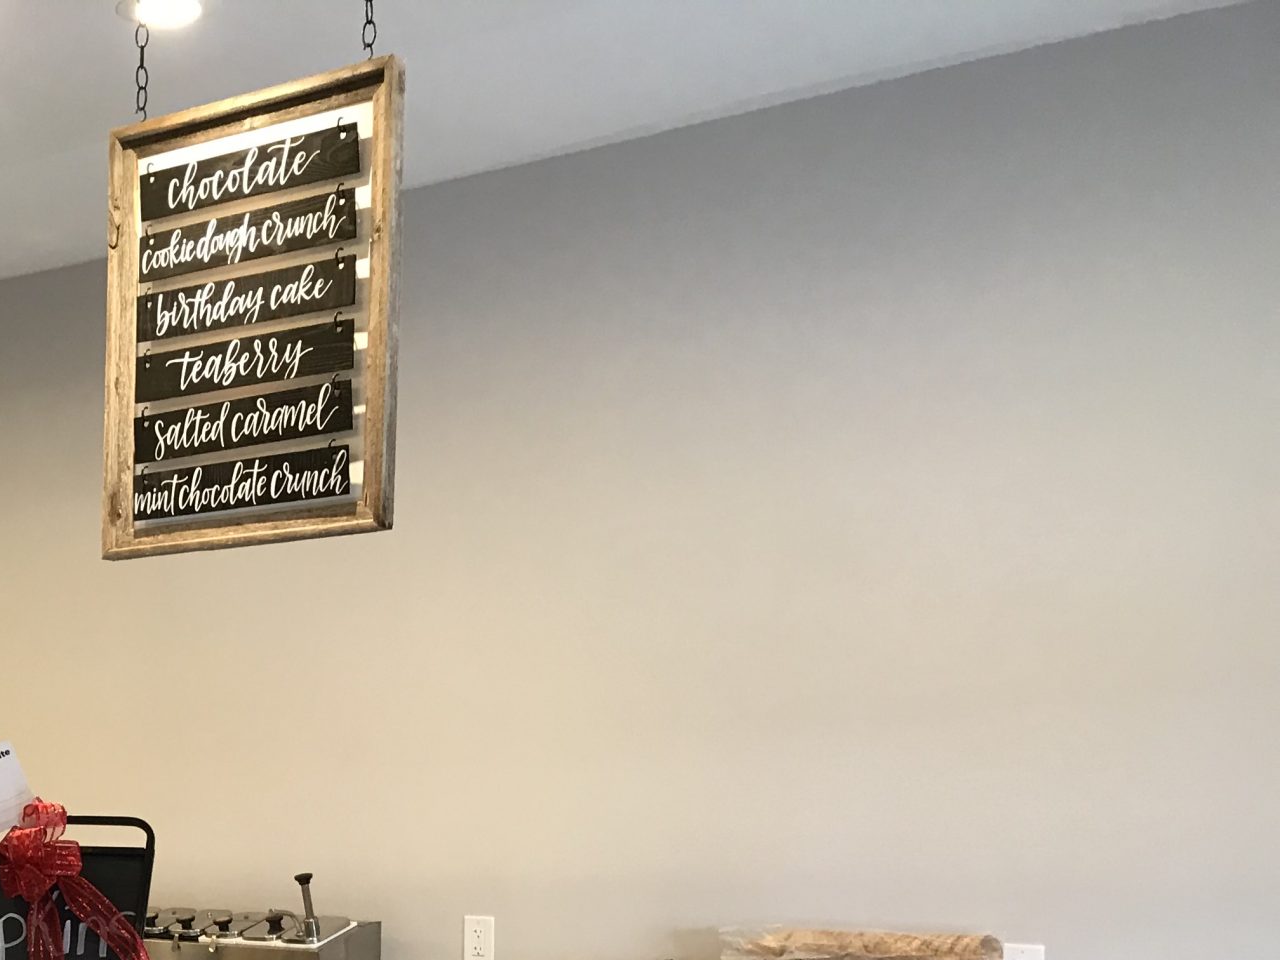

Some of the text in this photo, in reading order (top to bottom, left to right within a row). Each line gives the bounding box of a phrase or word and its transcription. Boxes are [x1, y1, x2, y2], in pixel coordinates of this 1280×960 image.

[168, 136, 320, 209] chocolate
[141, 193, 346, 274] cookie dough crunch
[155, 264, 333, 336] birthday cake
[165, 337, 314, 391] teaberry
[154, 382, 339, 461] salted caramel
[134, 449, 349, 516] mint chocolate crunch
